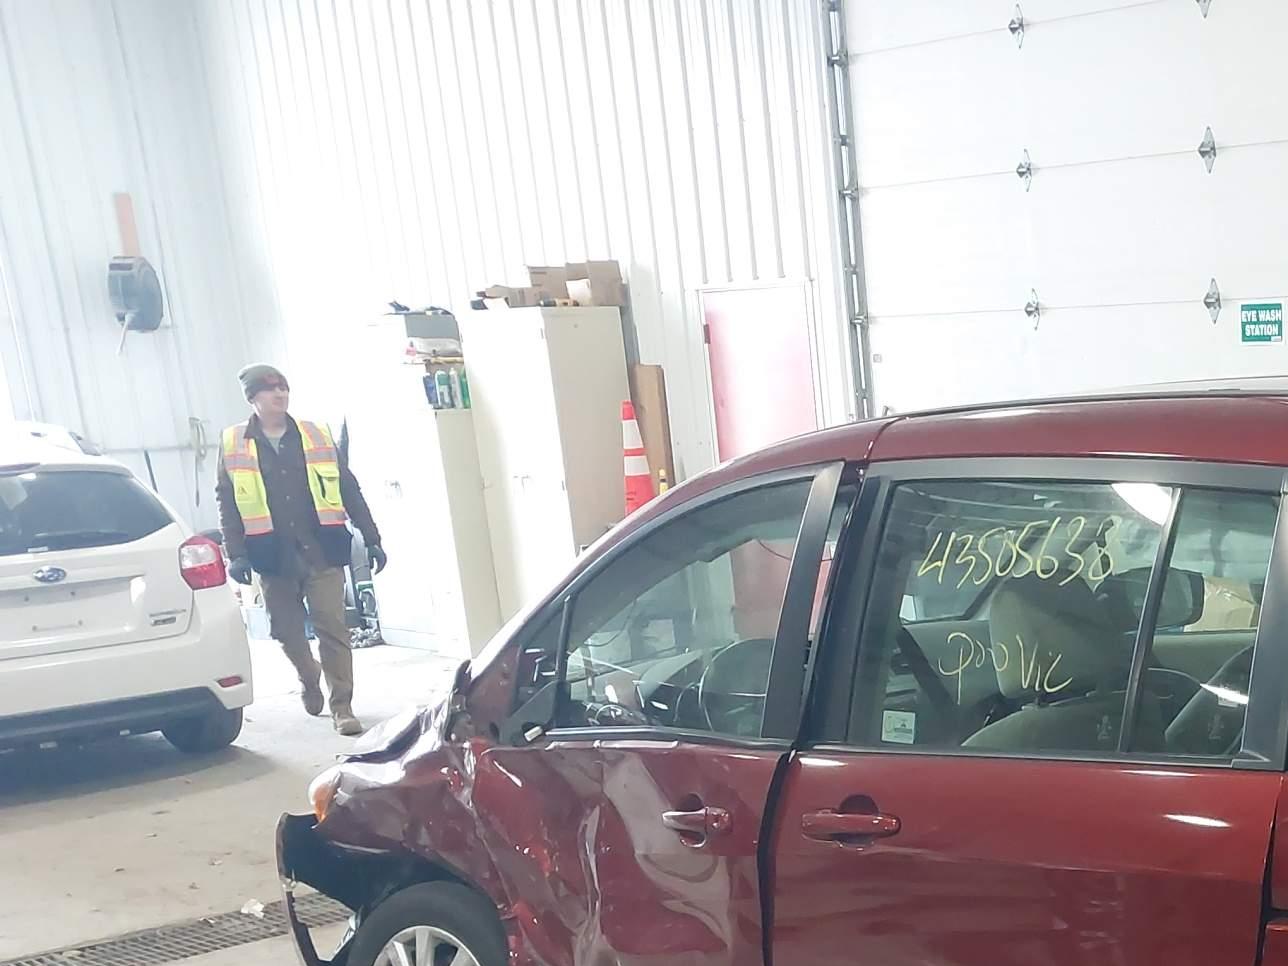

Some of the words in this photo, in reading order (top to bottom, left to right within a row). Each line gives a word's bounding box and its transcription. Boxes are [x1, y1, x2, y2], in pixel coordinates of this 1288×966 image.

[1241, 310, 1257, 322] EYE
[1258, 309, 1281, 322] WASH
[1245, 324, 1279, 336] STATION
[917, 516, 1117, 589] 43505638
